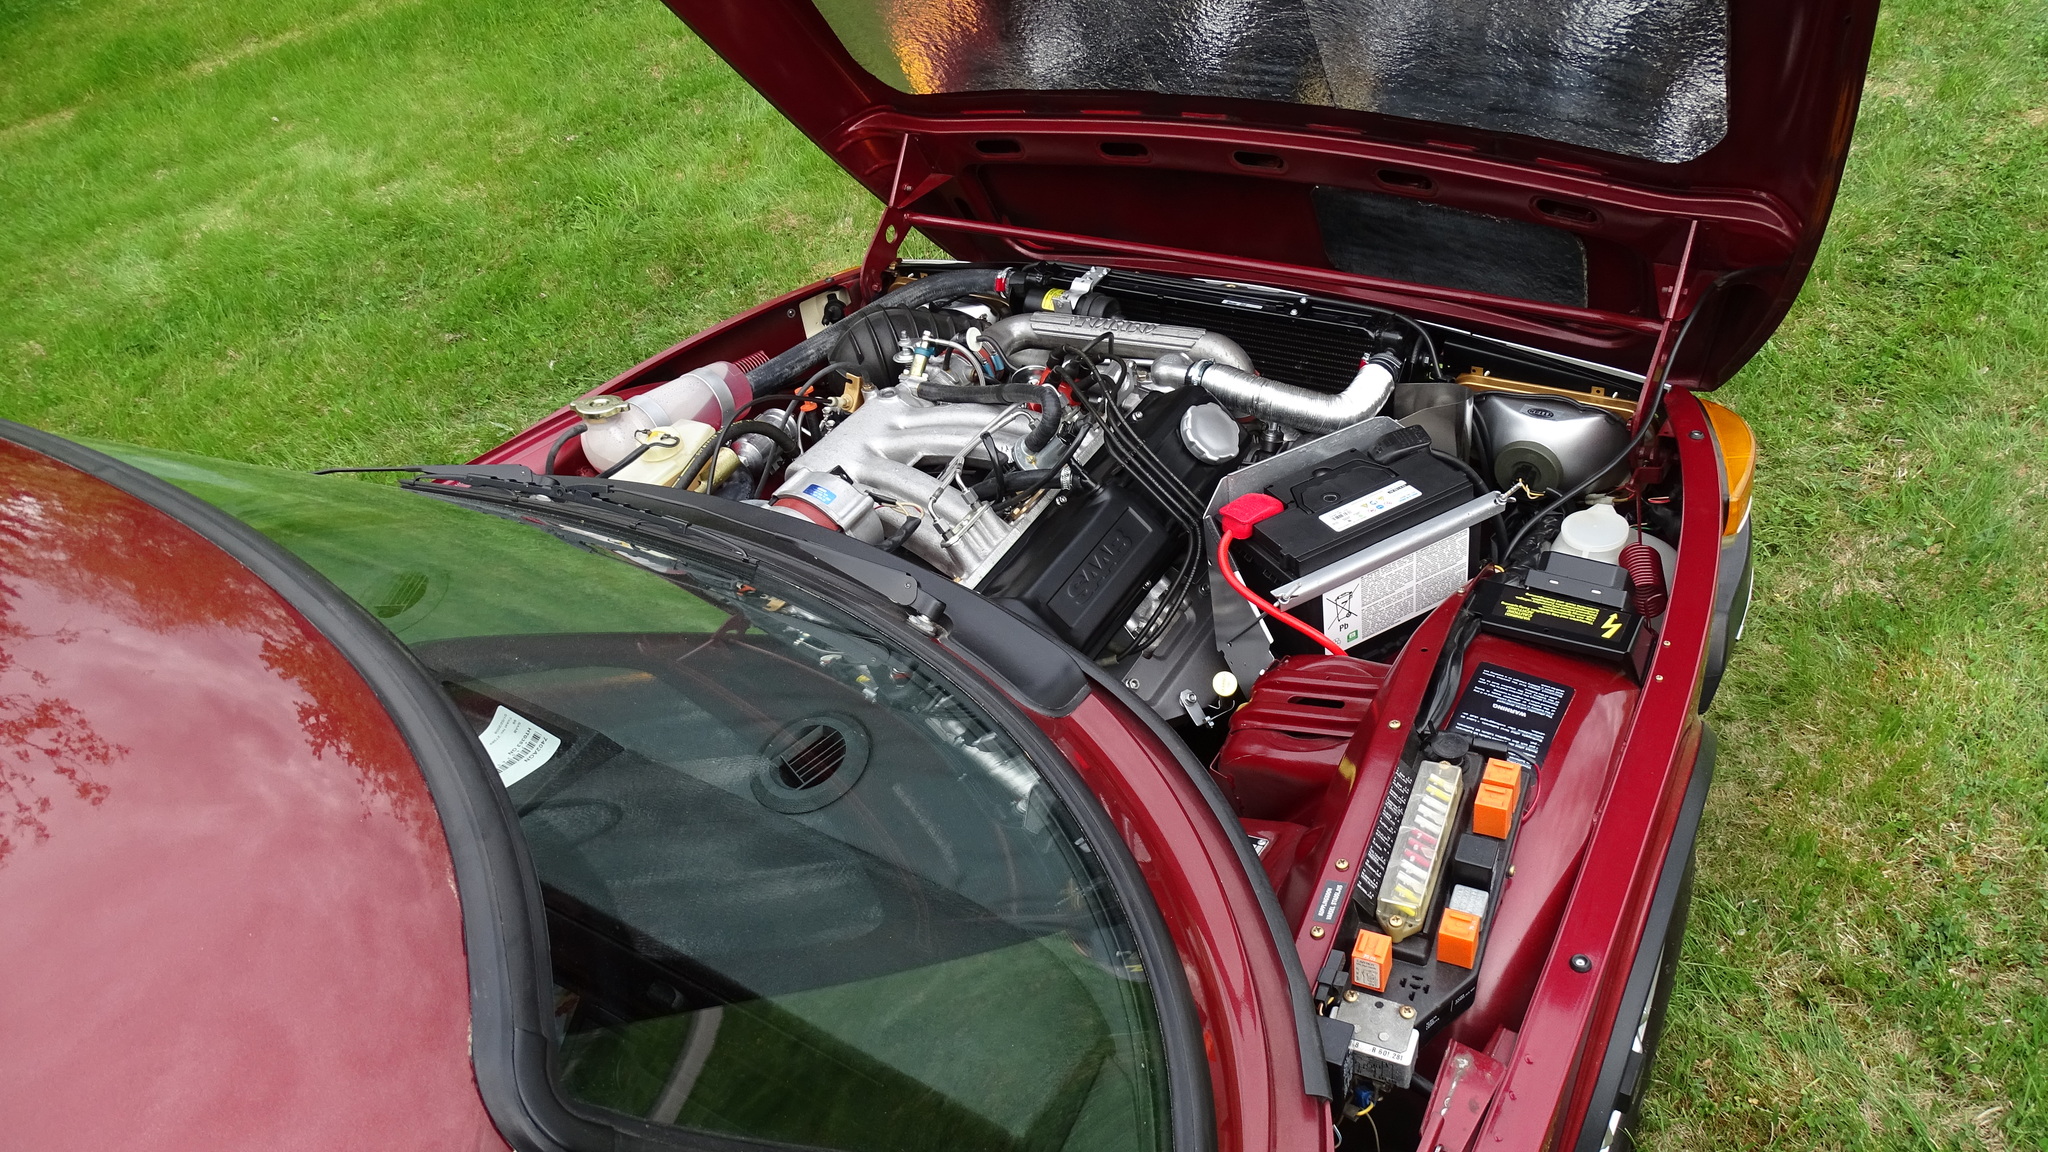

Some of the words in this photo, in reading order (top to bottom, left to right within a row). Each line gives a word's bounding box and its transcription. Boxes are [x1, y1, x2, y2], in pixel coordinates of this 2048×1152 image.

[1067, 531, 1133, 603] SAAB
[1339, 623, 1349, 632] Pb
[1491, 703, 1527, 717] WARNING
